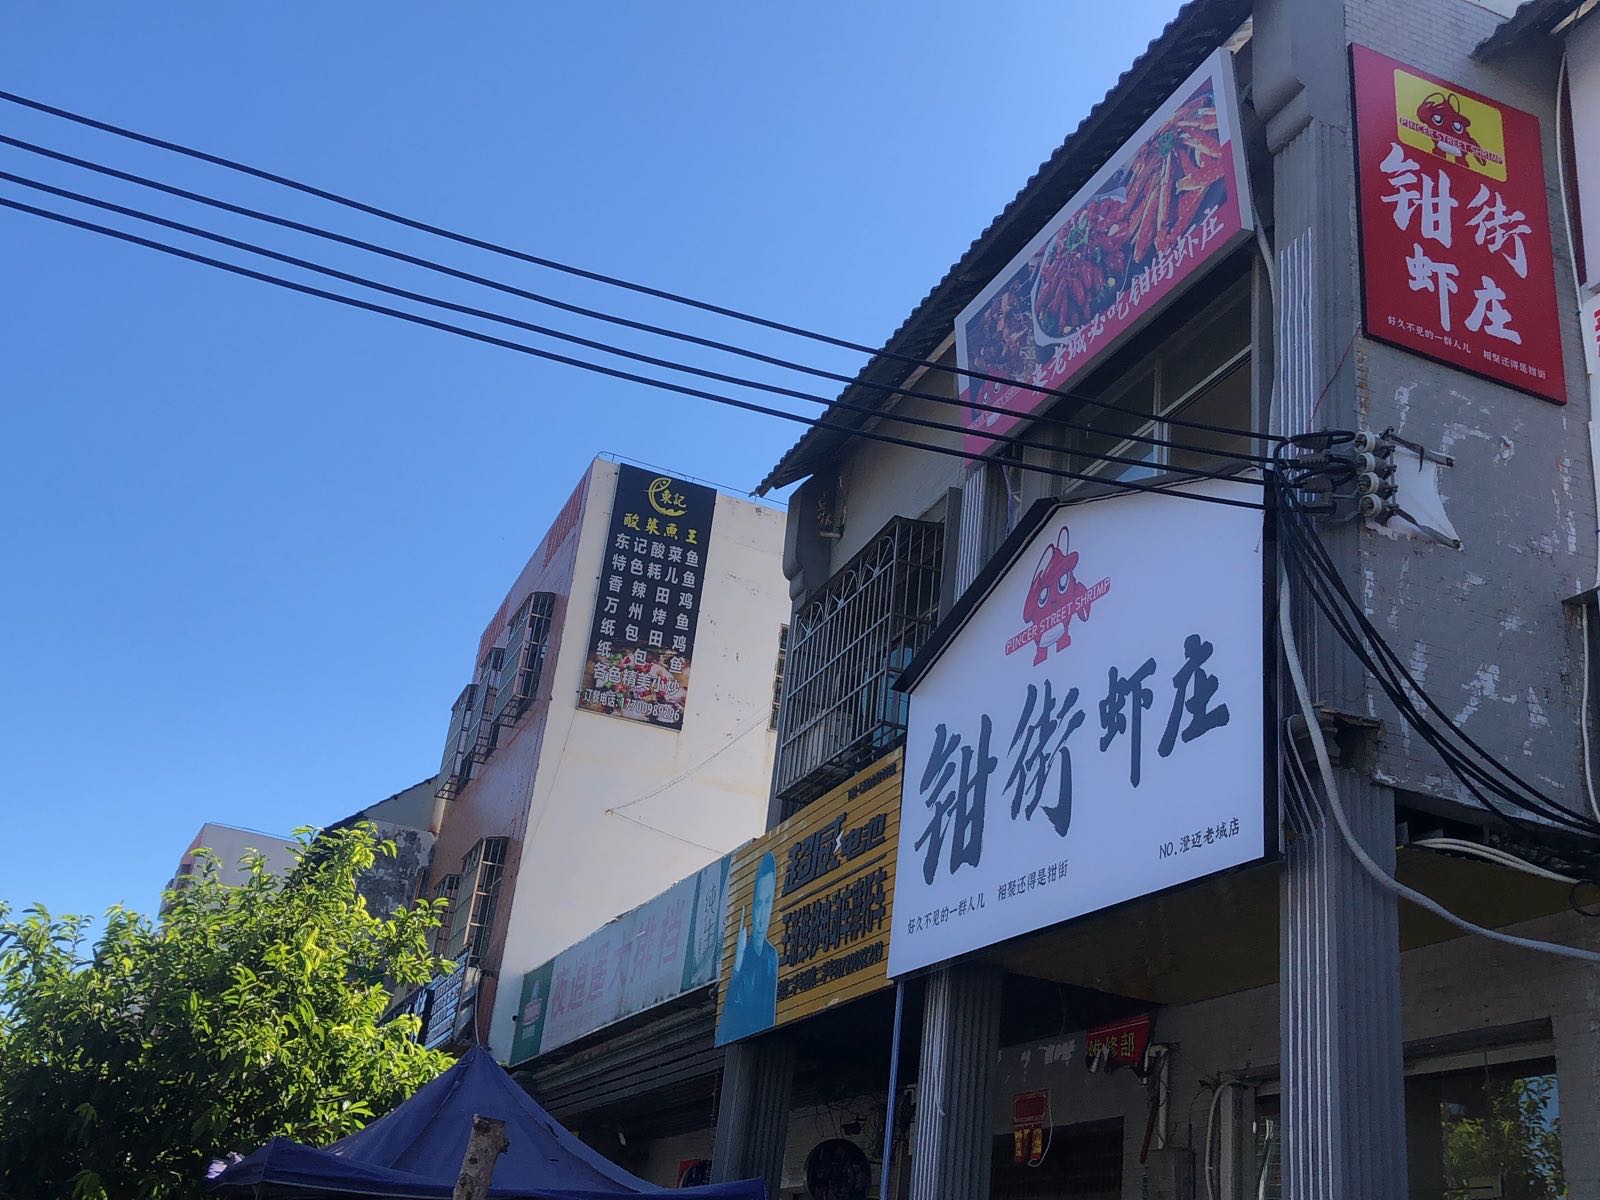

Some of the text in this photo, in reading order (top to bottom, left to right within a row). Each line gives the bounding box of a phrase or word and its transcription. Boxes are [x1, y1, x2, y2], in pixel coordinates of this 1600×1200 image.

[1435, 132, 1468, 153] STREET
[1470, 145, 1504, 165] SHRIMP
[1379, 142, 1533, 279] 钳街
[1405, 243, 1522, 345] 虾庄
[1386, 314, 1546, 380] 好久不见的一群人儿 相聚还得是钳街
[615, 532, 699, 568] 东记酸菜鱼
[611, 553, 696, 589] 特色耗儿鱼
[608, 574, 694, 610] 香辣田鸡
[604, 596, 689, 631] 万州烤鱼
[1006, 578, 1110, 655] PINCER STREET SHRIMP
[600, 617, 687, 653] 纸包田鸡
[596, 639, 683, 674] 纸包鱼
[593, 661, 681, 696] 各色精美小炒
[914, 633, 1231, 886] 钳街虾庄
[781, 811, 888, 898] 超威电池
[997, 859, 1068, 902] 相聚还得是钳街
[906, 892, 986, 936] 好久不见的一群人儿
